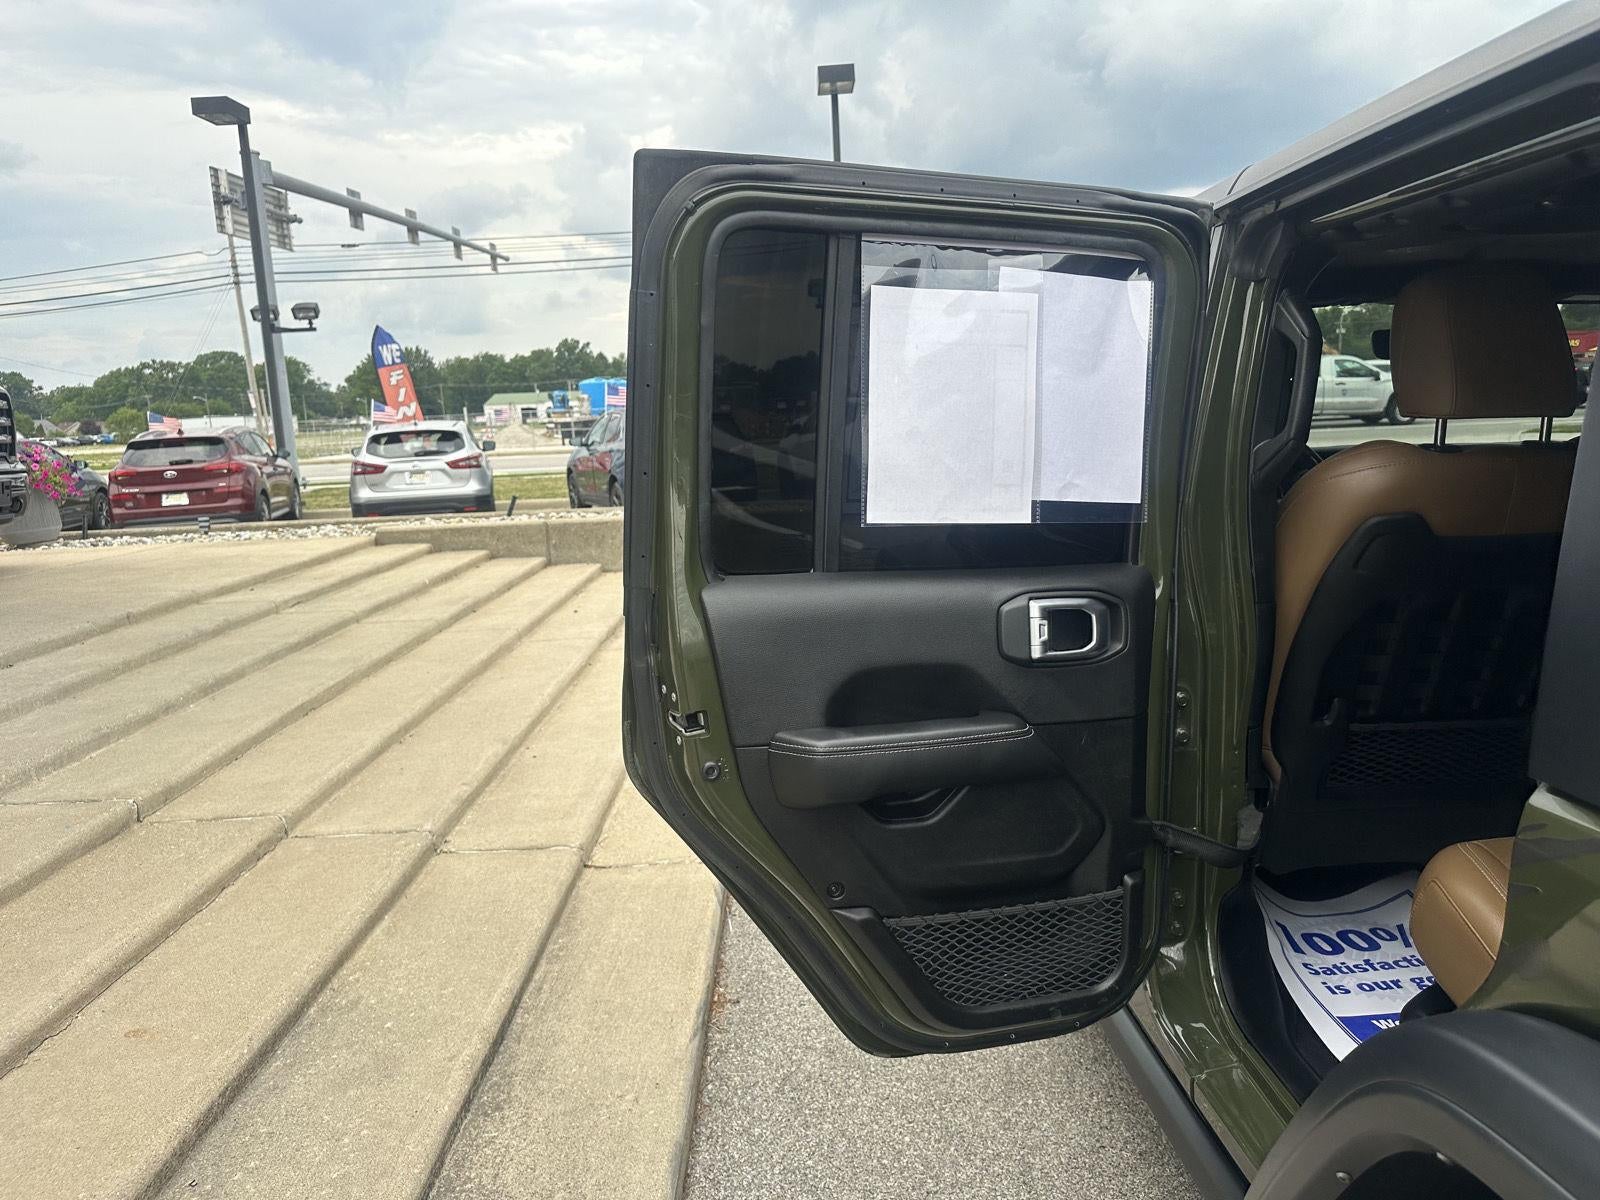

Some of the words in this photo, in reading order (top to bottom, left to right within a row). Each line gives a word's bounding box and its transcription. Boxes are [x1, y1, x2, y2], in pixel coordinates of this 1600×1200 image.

[379, 343, 401, 365] WE
[1321, 980, 1351, 995] is
[1356, 979, 1403, 992] our
